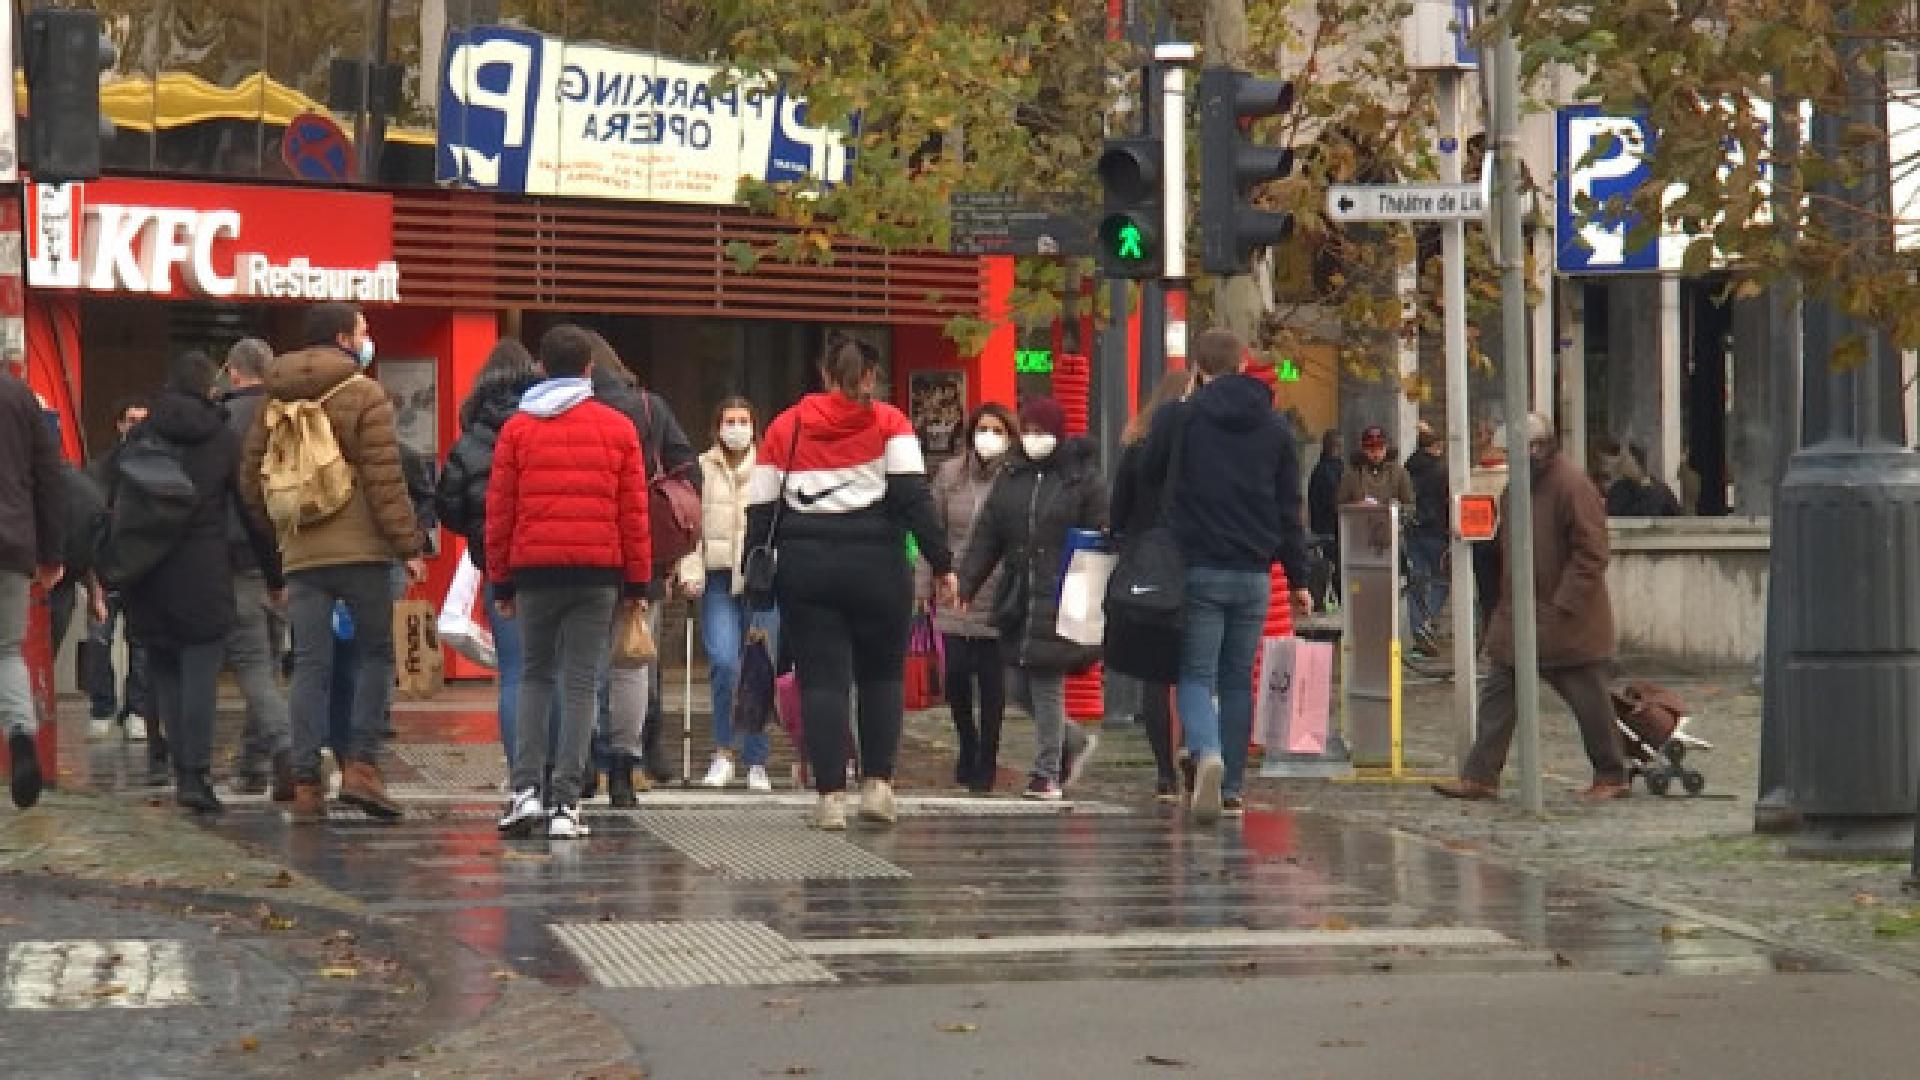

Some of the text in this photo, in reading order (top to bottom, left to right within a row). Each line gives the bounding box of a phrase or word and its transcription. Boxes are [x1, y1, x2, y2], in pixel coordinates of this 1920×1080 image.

[1437, 191, 1456, 212] de
[90, 204, 401, 302] KFC Restaurant
